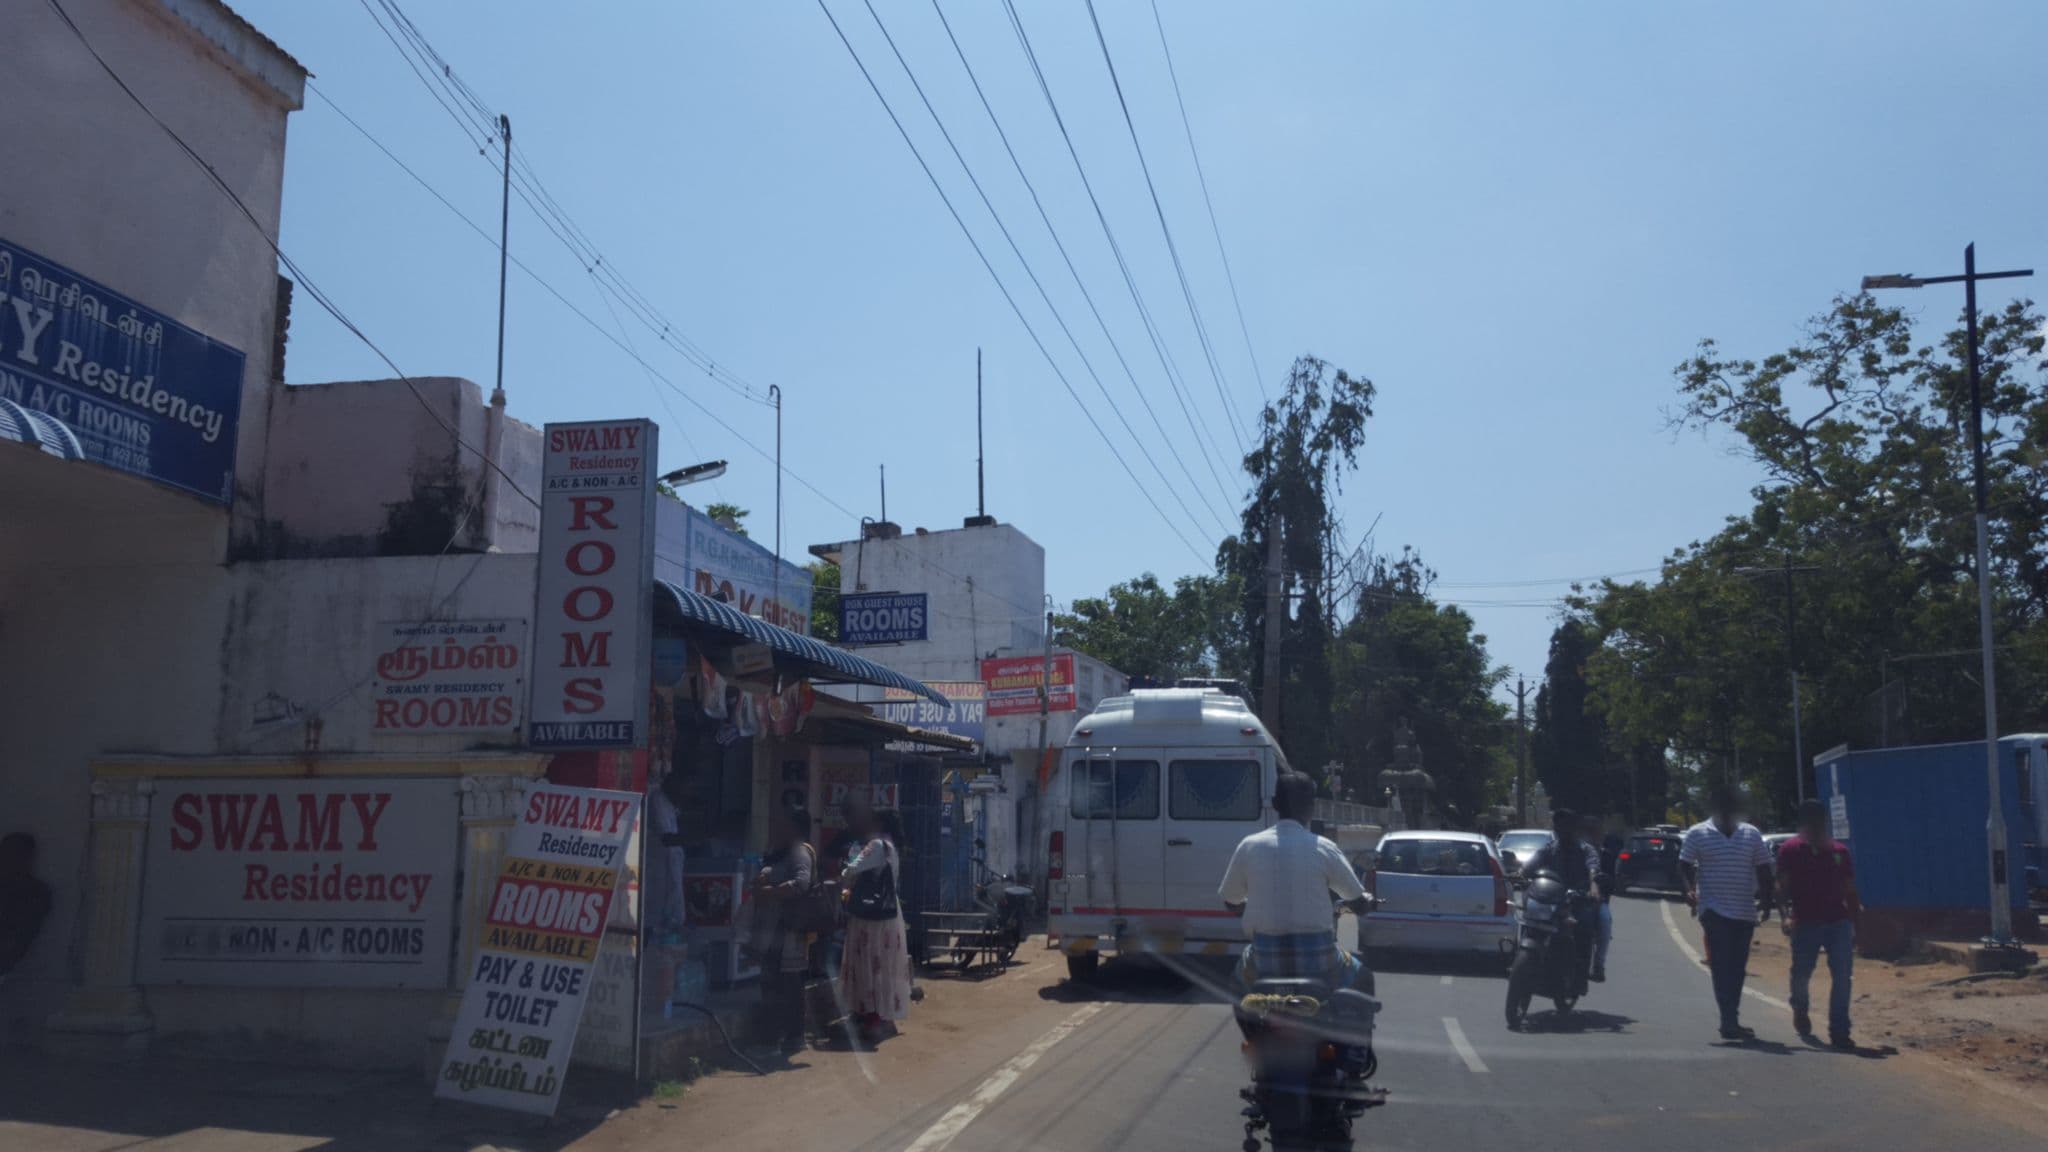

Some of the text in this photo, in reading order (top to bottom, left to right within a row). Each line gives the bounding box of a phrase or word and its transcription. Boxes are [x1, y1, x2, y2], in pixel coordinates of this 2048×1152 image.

[20, 268, 163, 347] ரெசிடென்சி
[53, 340, 223, 443] Residency
[30, 384, 151, 444] A/C ROOMS
[550, 426, 641, 453] SWAMY
[569, 454, 641, 471] Residency
[549, 478, 569, 489] A/C
[572, 478, 580, 488] &
[583, 476, 608, 488] NON
[618, 475, 638, 486] A/C
[560, 496, 618, 715] ROOMS
[864, 598, 892, 608] GUEST
[894, 597, 924, 607] HOUSE
[846, 607, 923, 632] ROOMS
[849, 630, 919, 642] AVAILABLE
[385, 683, 505, 695] SWAMY RESIDENCY
[374, 695, 513, 728] ROOMS
[534, 723, 629, 741] AVAILABLE
[169, 793, 392, 851] SWAMY
[524, 791, 630, 833] SWAMY
[538, 832, 619, 865] Residency
[243, 862, 432, 913] Residency
[508, 861, 611, 886] A/C & NON A/C
[493, 881, 604, 934] ROOMS
[296, 927, 335, 953] A/C
[342, 927, 424, 955] ROOMS
[488, 927, 592, 959] AVAILABLE
[475, 955, 517, 985] PAY
[518, 960, 535, 989] &
[540, 963, 585, 996] USE
[484, 991, 559, 1027] TOILET
[468, 1028, 552, 1060] கட்டண
[444, 1055, 557, 1096] கழிப்பிடம்
